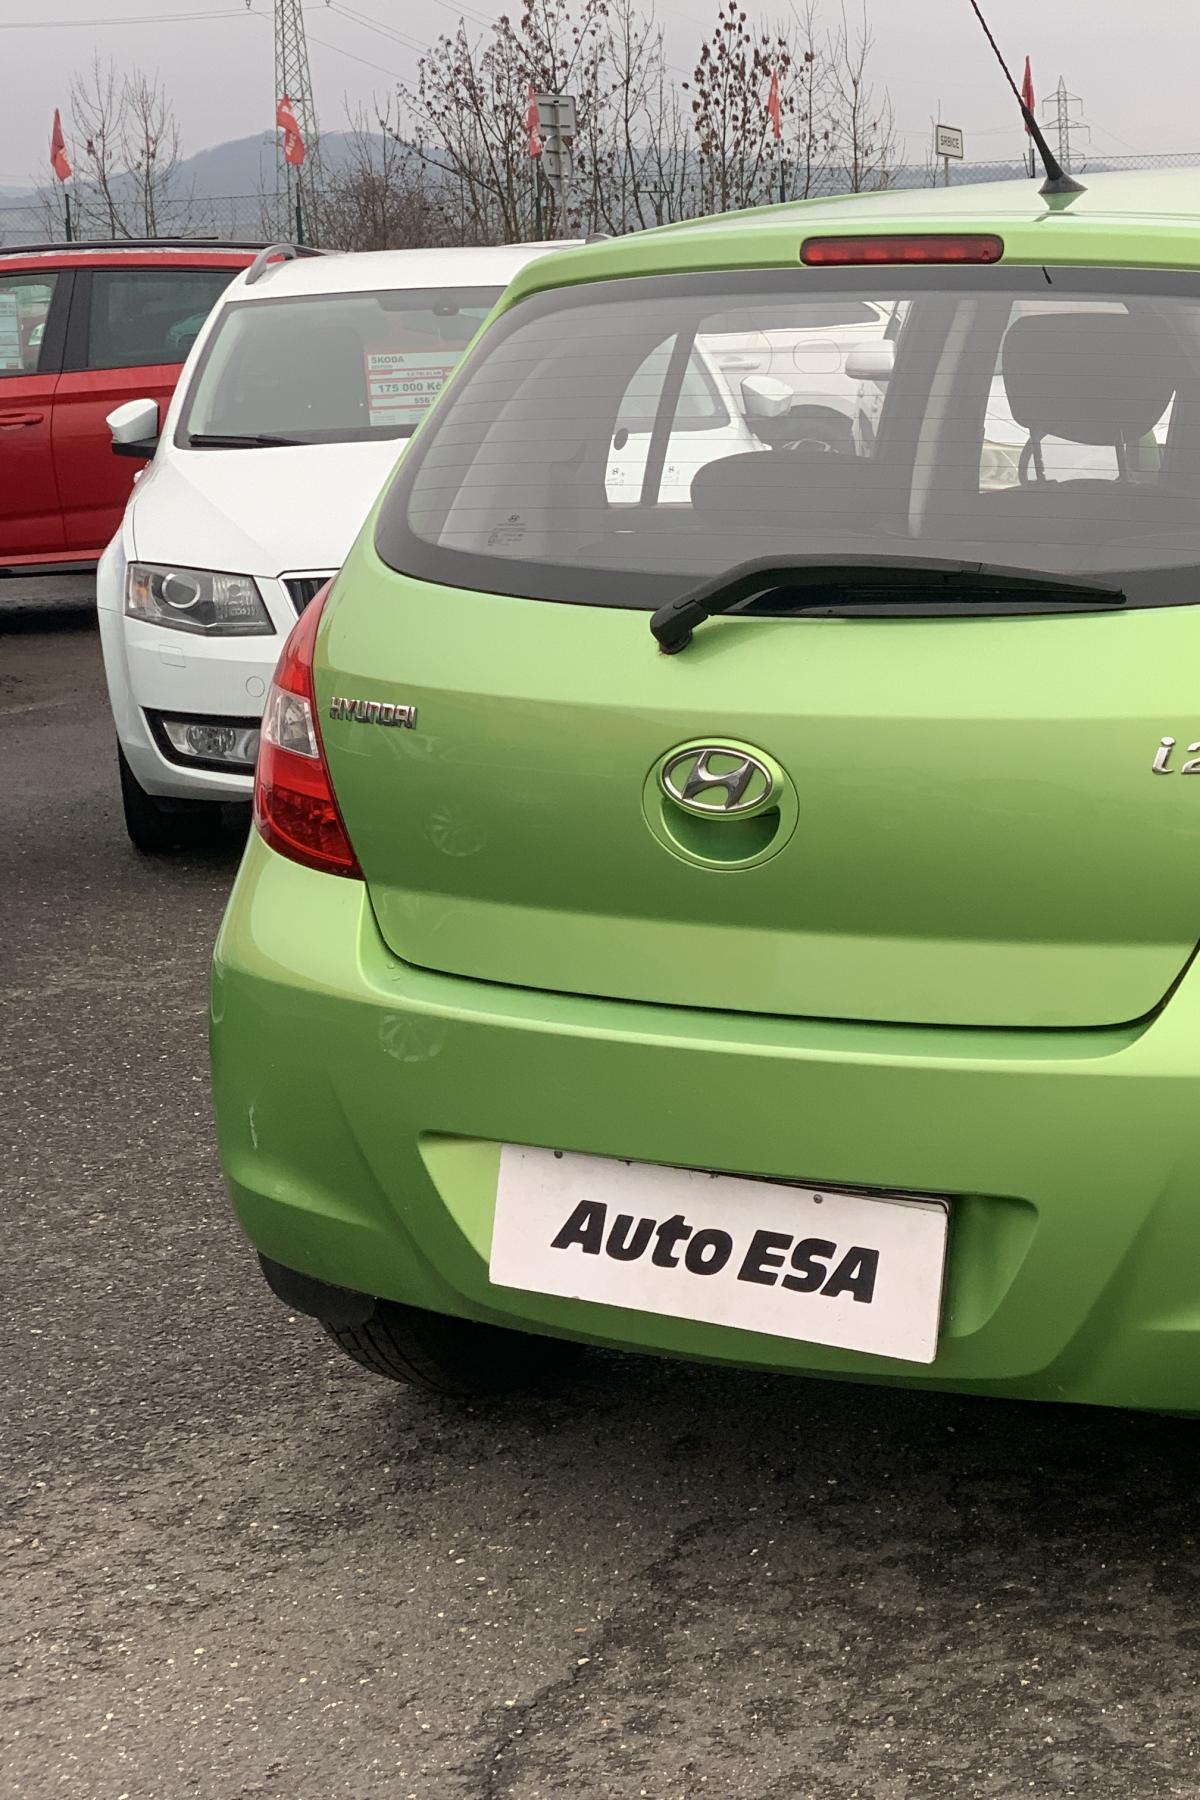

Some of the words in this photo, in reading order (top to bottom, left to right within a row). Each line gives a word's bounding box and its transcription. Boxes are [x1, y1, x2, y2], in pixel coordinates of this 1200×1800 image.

[378, 384, 399, 392] 175
[402, 383, 423, 392] 000
[329, 696, 417, 729] HYUNDAI
[550, 1199, 733, 1276] Auto
[737, 1229, 880, 1304] ESA
